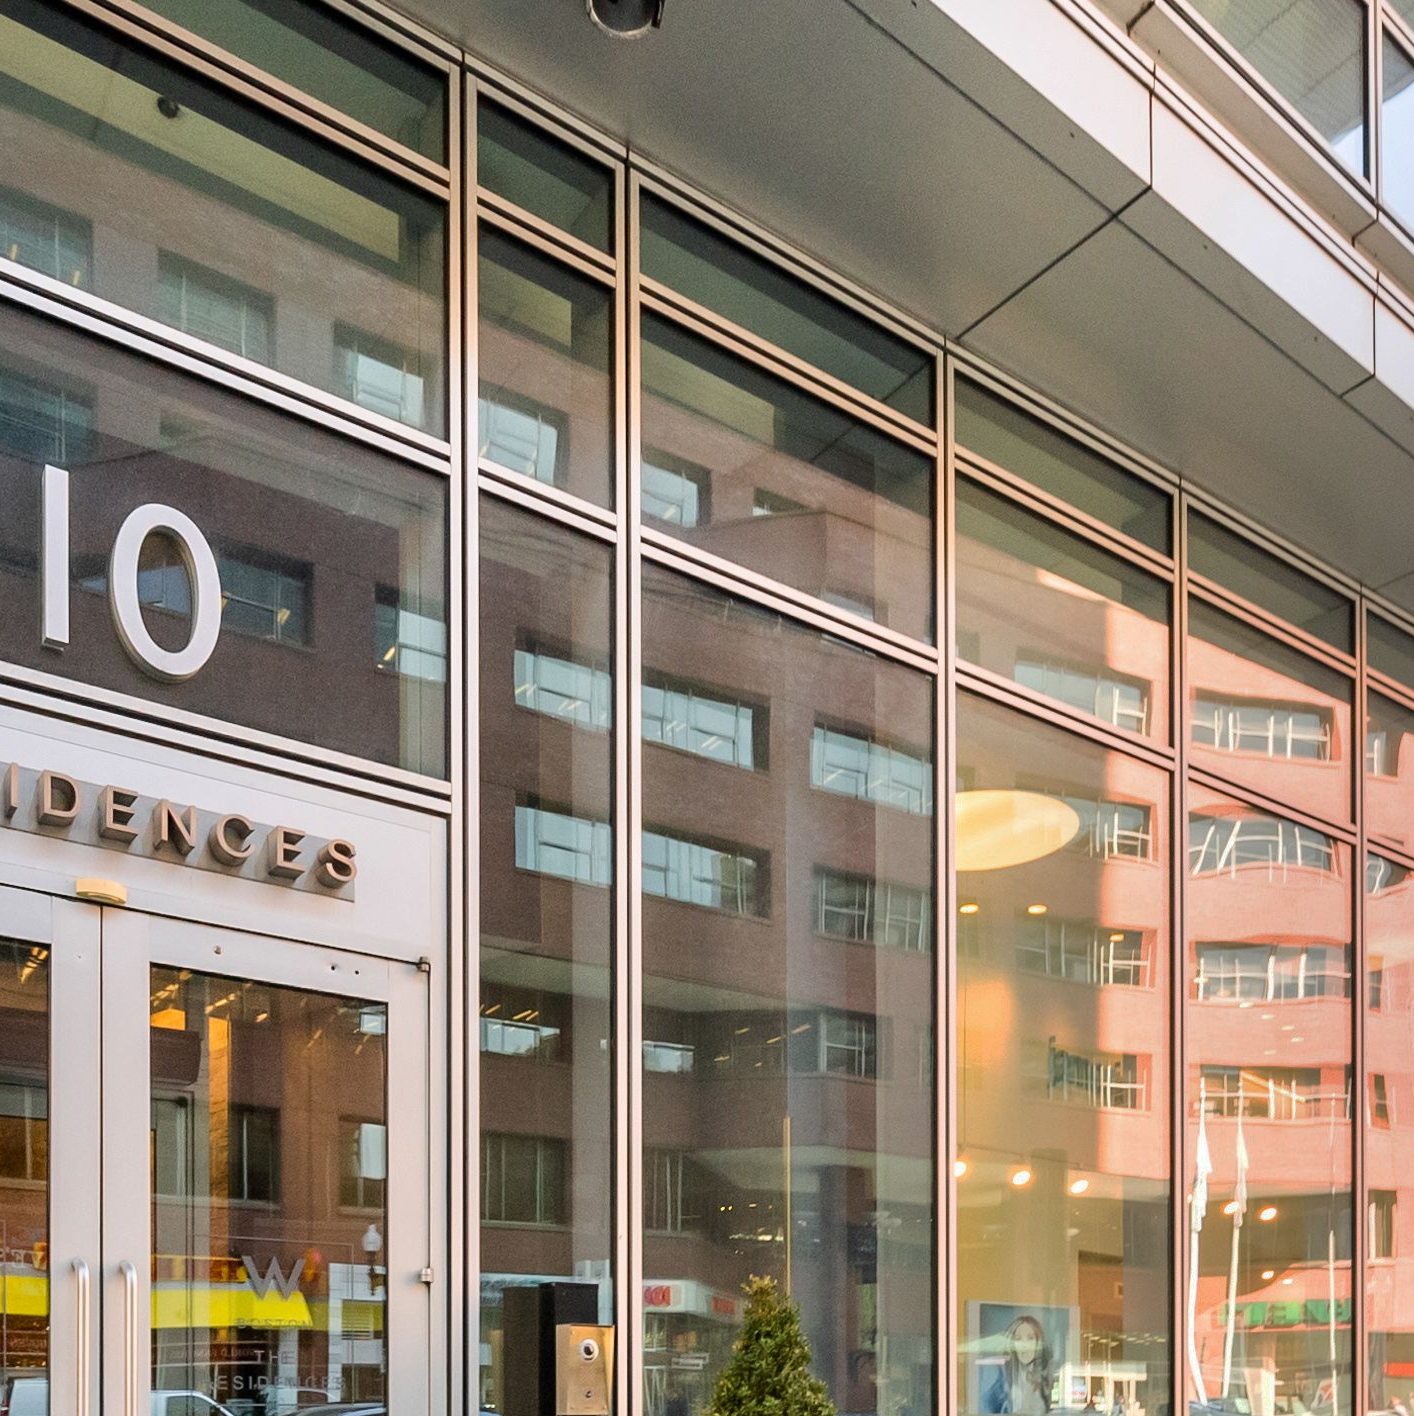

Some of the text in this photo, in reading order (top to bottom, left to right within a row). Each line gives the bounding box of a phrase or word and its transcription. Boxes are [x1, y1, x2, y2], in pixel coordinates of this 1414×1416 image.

[241, 1255, 306, 1300] W
[253, 1349, 297, 1365] THE
[209, 1374, 347, 1391] ESIDENCES
